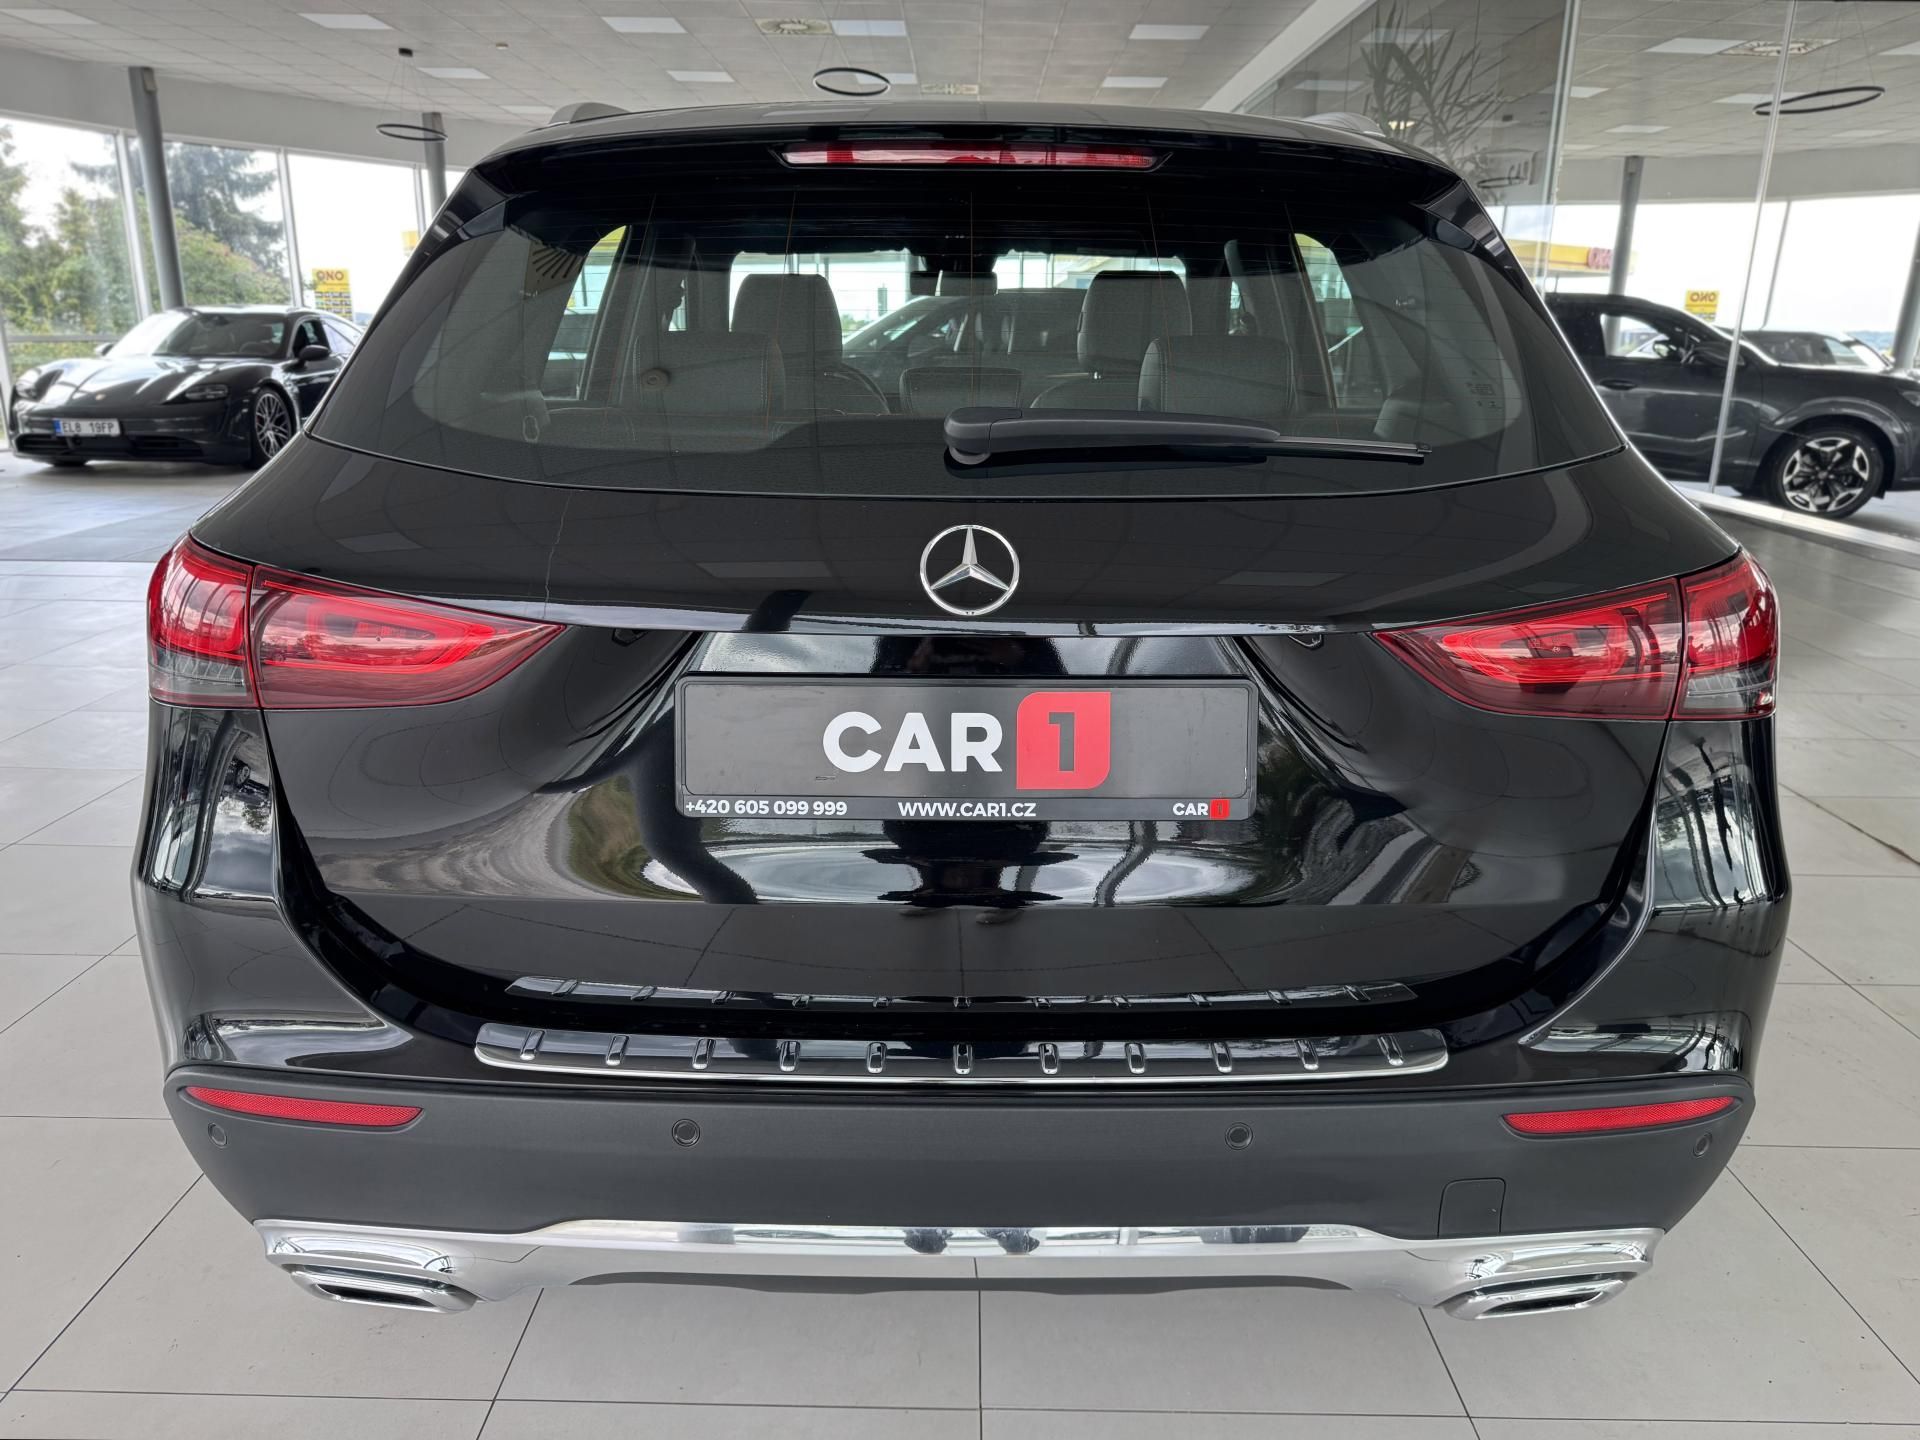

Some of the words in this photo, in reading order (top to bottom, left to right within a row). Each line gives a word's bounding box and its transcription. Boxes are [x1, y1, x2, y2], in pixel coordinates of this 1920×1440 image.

[685, 799, 730, 814] +420
[734, 800, 769, 814] 605
[773, 800, 809, 815] 099
[813, 801, 848, 815] 999
[898, 802, 1037, 817] WWW.CAR1.CZ
